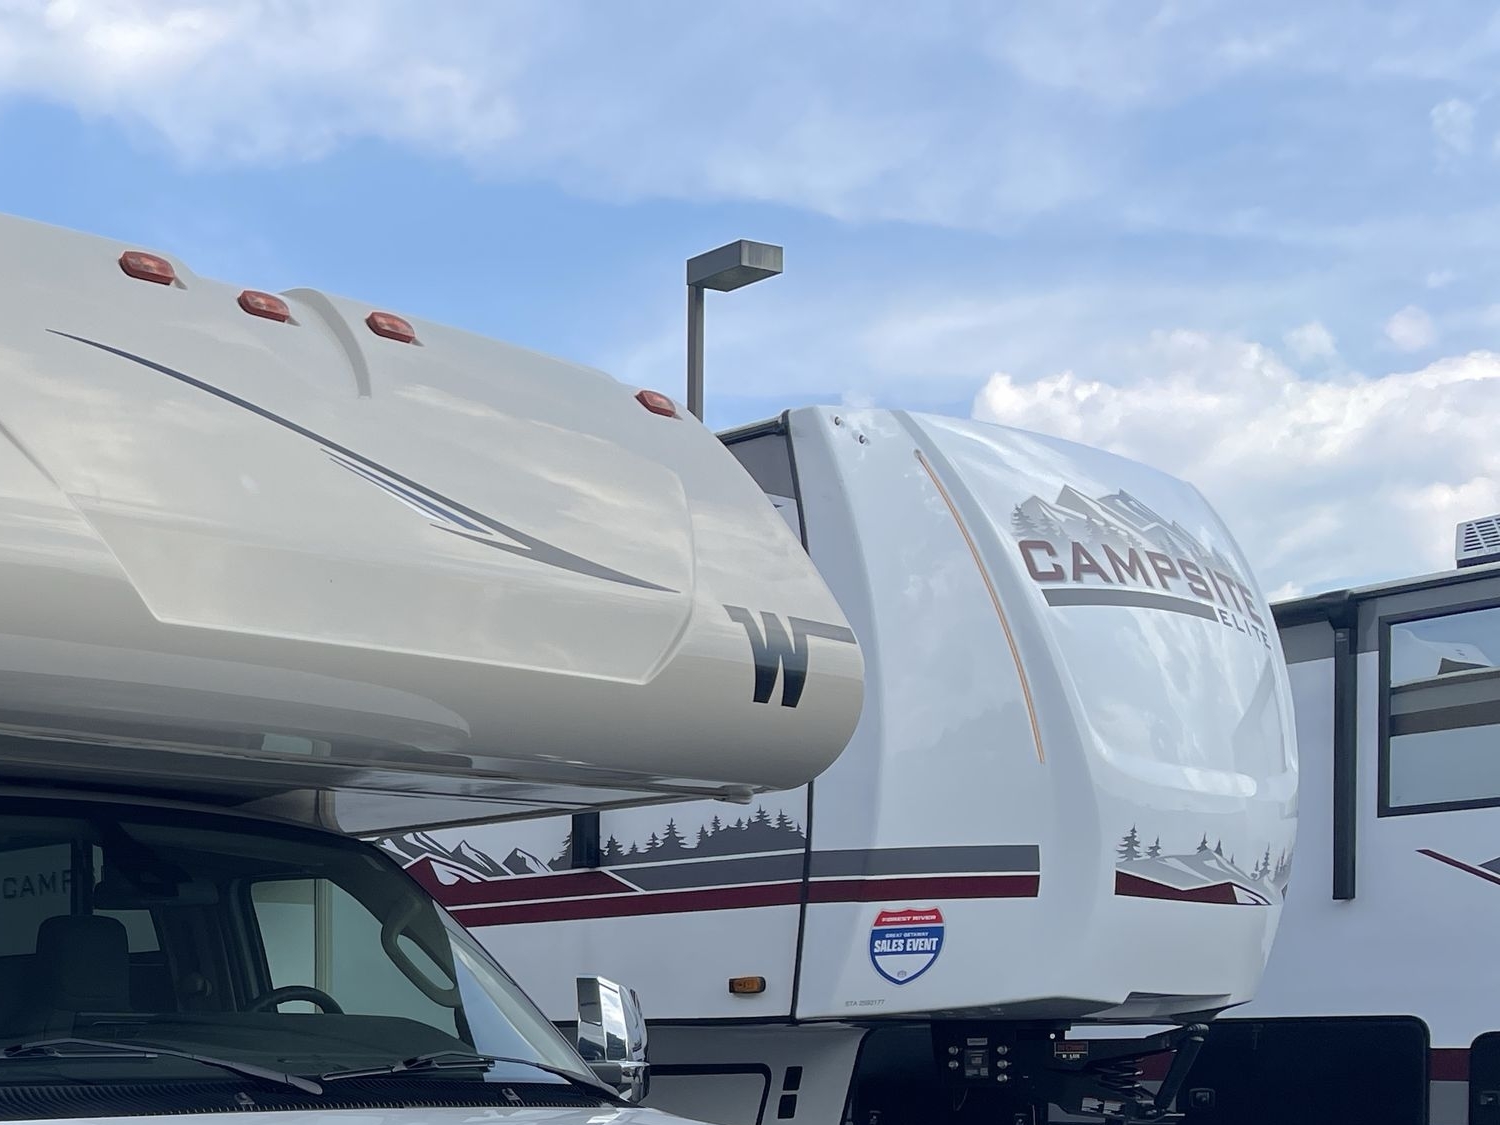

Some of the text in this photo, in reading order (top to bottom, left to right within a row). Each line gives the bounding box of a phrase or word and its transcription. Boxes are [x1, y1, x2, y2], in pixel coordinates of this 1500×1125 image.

[1018, 540, 1266, 629] CAMPSITE
[1217, 608, 1272, 650] ELITE
[874, 937, 939, 953] SALES EVENT
